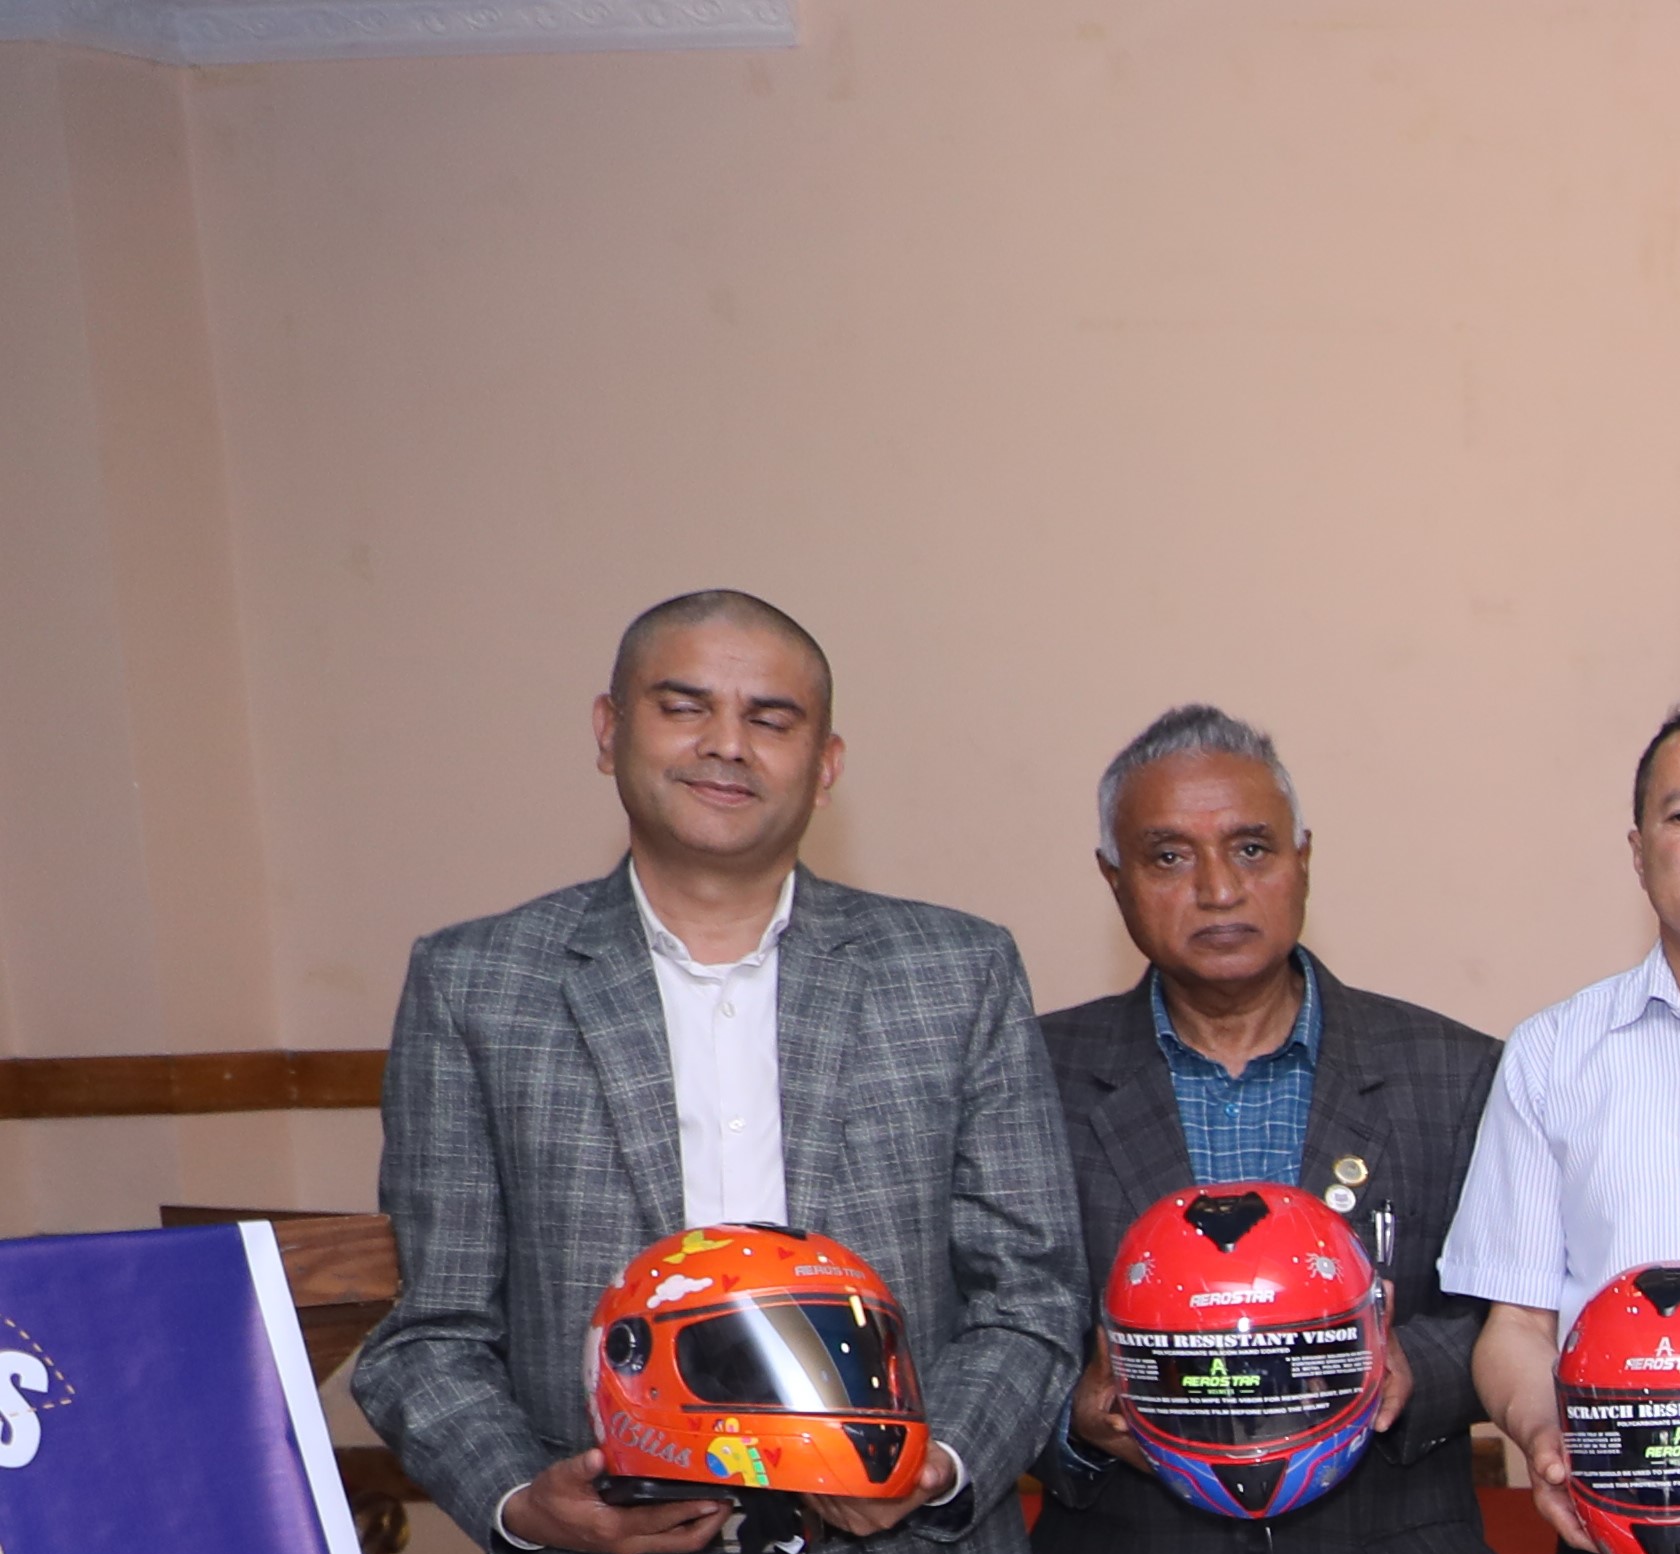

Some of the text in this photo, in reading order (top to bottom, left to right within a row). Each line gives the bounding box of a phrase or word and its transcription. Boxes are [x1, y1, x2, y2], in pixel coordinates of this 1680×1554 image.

[1190, 1290, 1275, 1308] AEROSTAR
[1174, 1332, 1298, 1348] RESISTANT
[1302, 1327, 1358, 1345] VISOR
[1182, 1375, 1261, 1387] AEROSTAR
[1567, 1404, 1633, 1420] SCRATCH
[609, 1409, 693, 1469] Bliss
